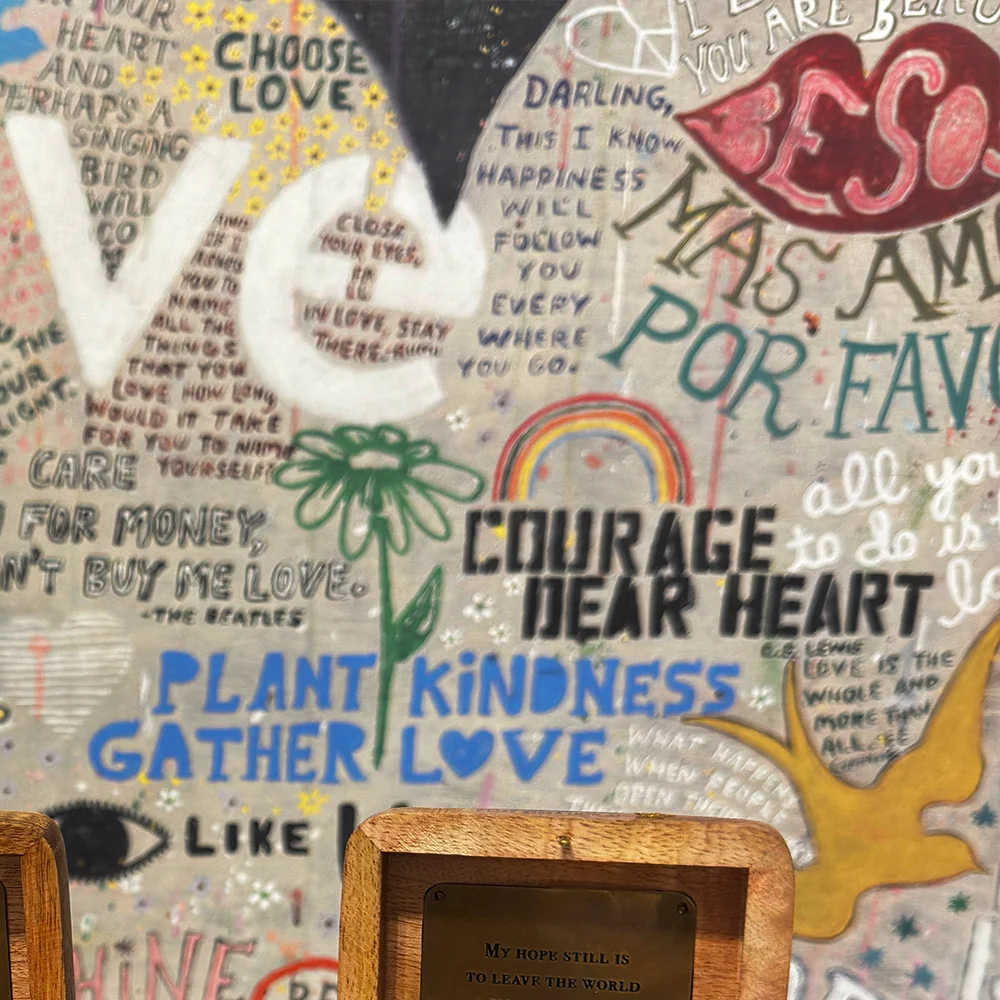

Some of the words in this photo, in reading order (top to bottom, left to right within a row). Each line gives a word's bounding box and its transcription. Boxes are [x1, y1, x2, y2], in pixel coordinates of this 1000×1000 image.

[56, 14, 180, 64] HEART
[214, 31, 369, 75] CHOOSE
[40, 55, 113, 88] AND
[230, 74, 355, 113] LOVE
[525, 73, 674, 117] DARLING,
[496, 124, 556, 149] THIS
[572, 126, 589, 147] I
[608, 126, 685, 153] KNOW
[79, 155, 162, 189] BIRD
[476, 164, 646, 190] HAPPINESS
[500, 199, 592, 219] WILL
[493, 230, 603, 253] FOLLOW
[517, 261, 581, 281] YOU
[491, 294, 593, 316] EVERY
[477, 328, 588, 349] WHERE
[457, 358, 512, 378] YOU
[528, 357, 579, 377] GO.
[600, 285, 807, 439] POR
[29, 449, 140, 491] CARE
[803, 447, 908, 520] all
[18, 501, 98, 544] FOR
[112, 502, 270, 556] MONEY,
[462, 505, 779, 575] COURAGE
[84, 555, 166, 600] BUY
[176, 560, 236, 599] ME
[243, 560, 369, 602] LOVE.
[204, 607, 305, 630] BEATLES
[521, 574, 697, 640] DEAR
[719, 572, 934, 636] HEART
[152, 650, 377, 714] PLANT
[88, 720, 367, 785] GATHER
[185, 815, 309, 857] LIKE
[516, 949, 557, 961] HOPE
[564, 951, 609, 963] STILL
[615, 954, 630, 965] IS
[466, 972, 486, 983] TO
[492, 974, 540, 986] LEAVE
[546, 977, 577, 988] THE
[582, 978, 641, 992] WORLD
